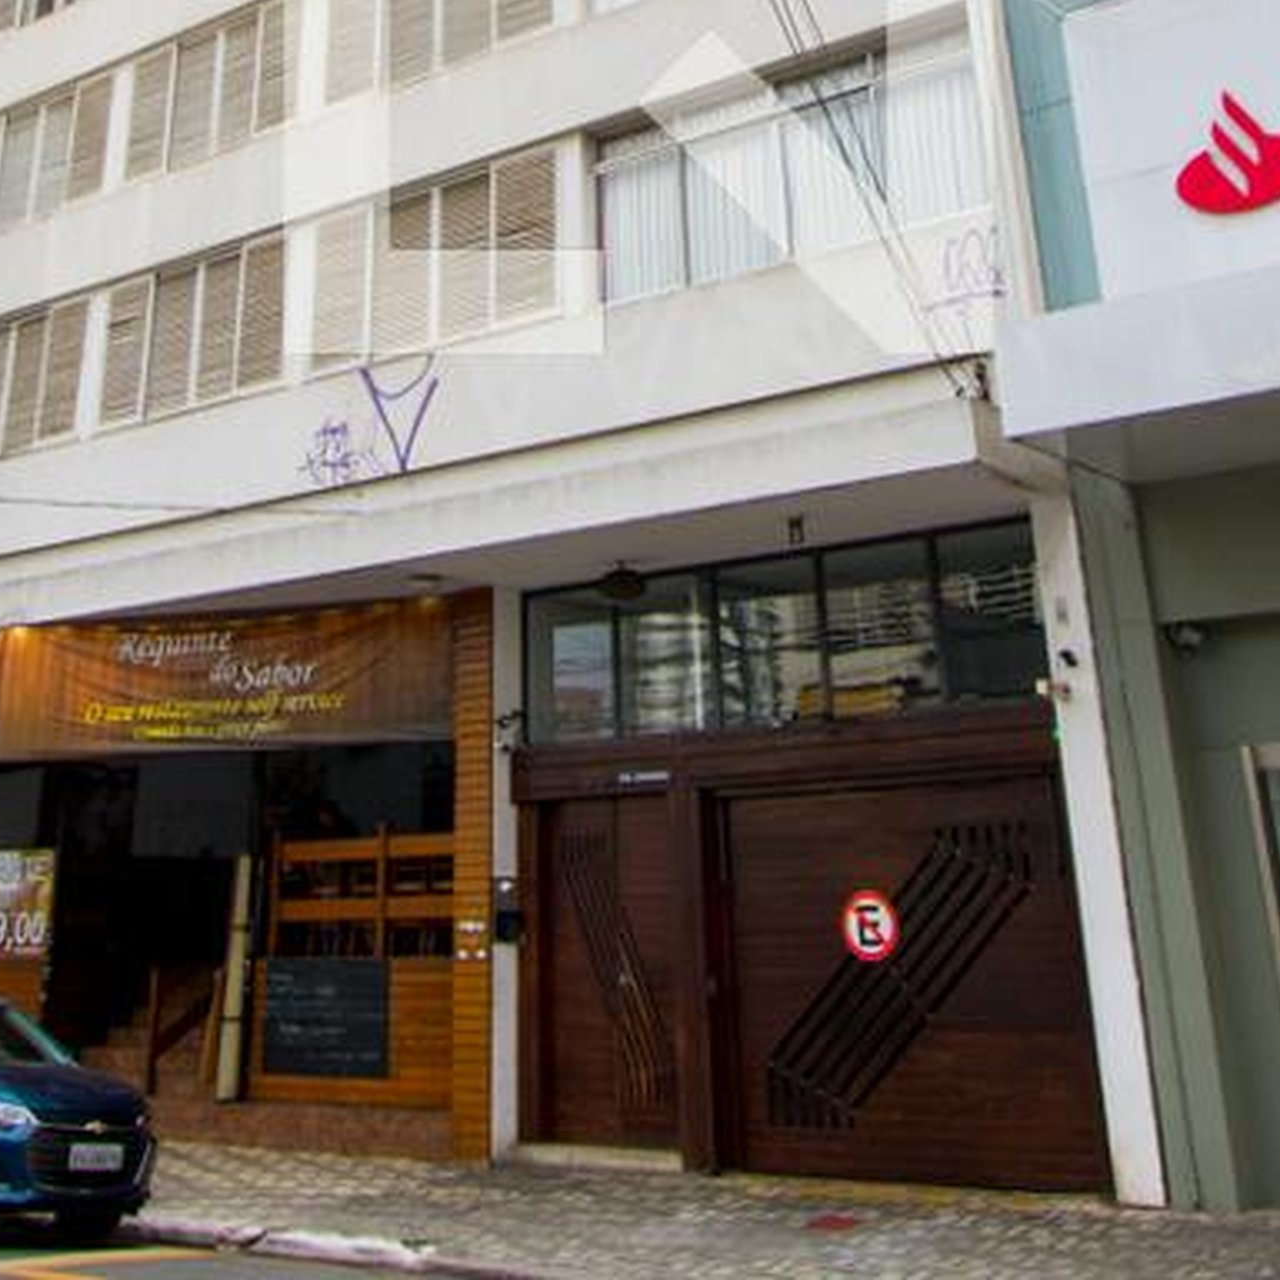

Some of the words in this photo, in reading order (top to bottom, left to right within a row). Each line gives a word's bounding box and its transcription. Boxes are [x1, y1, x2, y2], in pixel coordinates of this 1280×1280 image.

[118, 631, 234, 665] Requinte
[233, 656, 318, 691] Sabor
[854, 904, 884, 946] E
